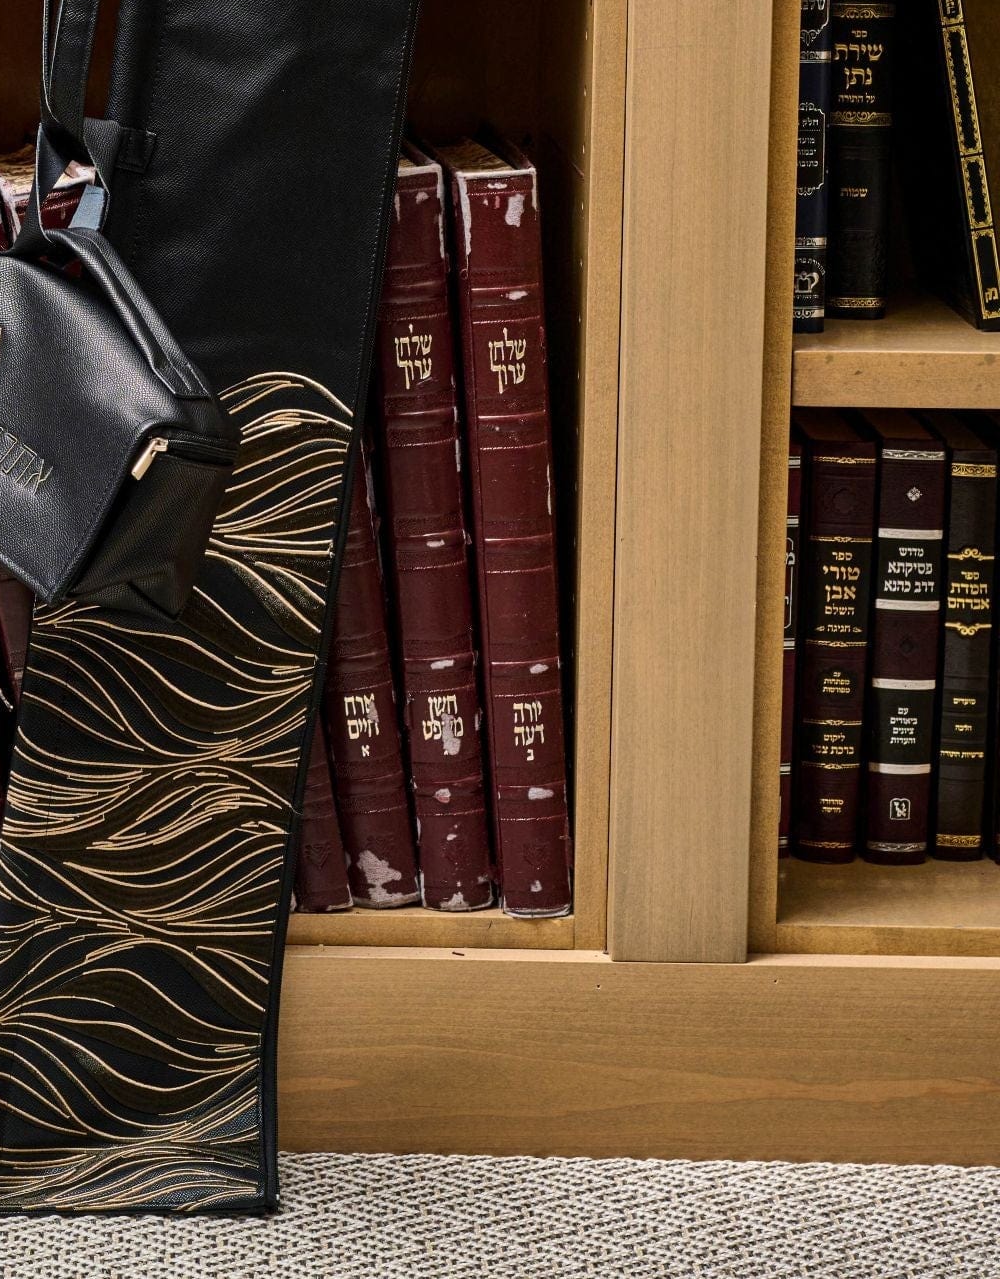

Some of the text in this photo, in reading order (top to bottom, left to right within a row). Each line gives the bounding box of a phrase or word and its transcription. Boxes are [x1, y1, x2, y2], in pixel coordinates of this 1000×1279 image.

[835, 44, 882, 61] שירת
[845, 68, 872, 89] נתן
[840, 188, 868, 197] שמות
[394, 323, 432, 361] שלחן
[489, 328, 526, 366] שלחן
[397, 358, 432, 390] ערוך
[491, 363, 525, 394] ערוך
[832, 552, 852, 560] ספר
[899, 548, 923, 557] מדרש
[823, 566, 860, 580] טורי
[888, 561, 932, 577] פסיקתא
[961, 571, 979, 580] ספר
[825, 585, 856, 602] אבן
[950, 583, 987, 594] חמדת
[825, 604, 854, 615] השלם
[948, 597, 989, 609] אברהם
[427, 694, 457, 725] חשן
[513, 701, 542, 723] יורה
[347, 715, 379, 739] חיים
[514, 724, 544, 746] דעה
[824, 733, 845, 742] ליקוט
[361, 744, 370, 757] א
